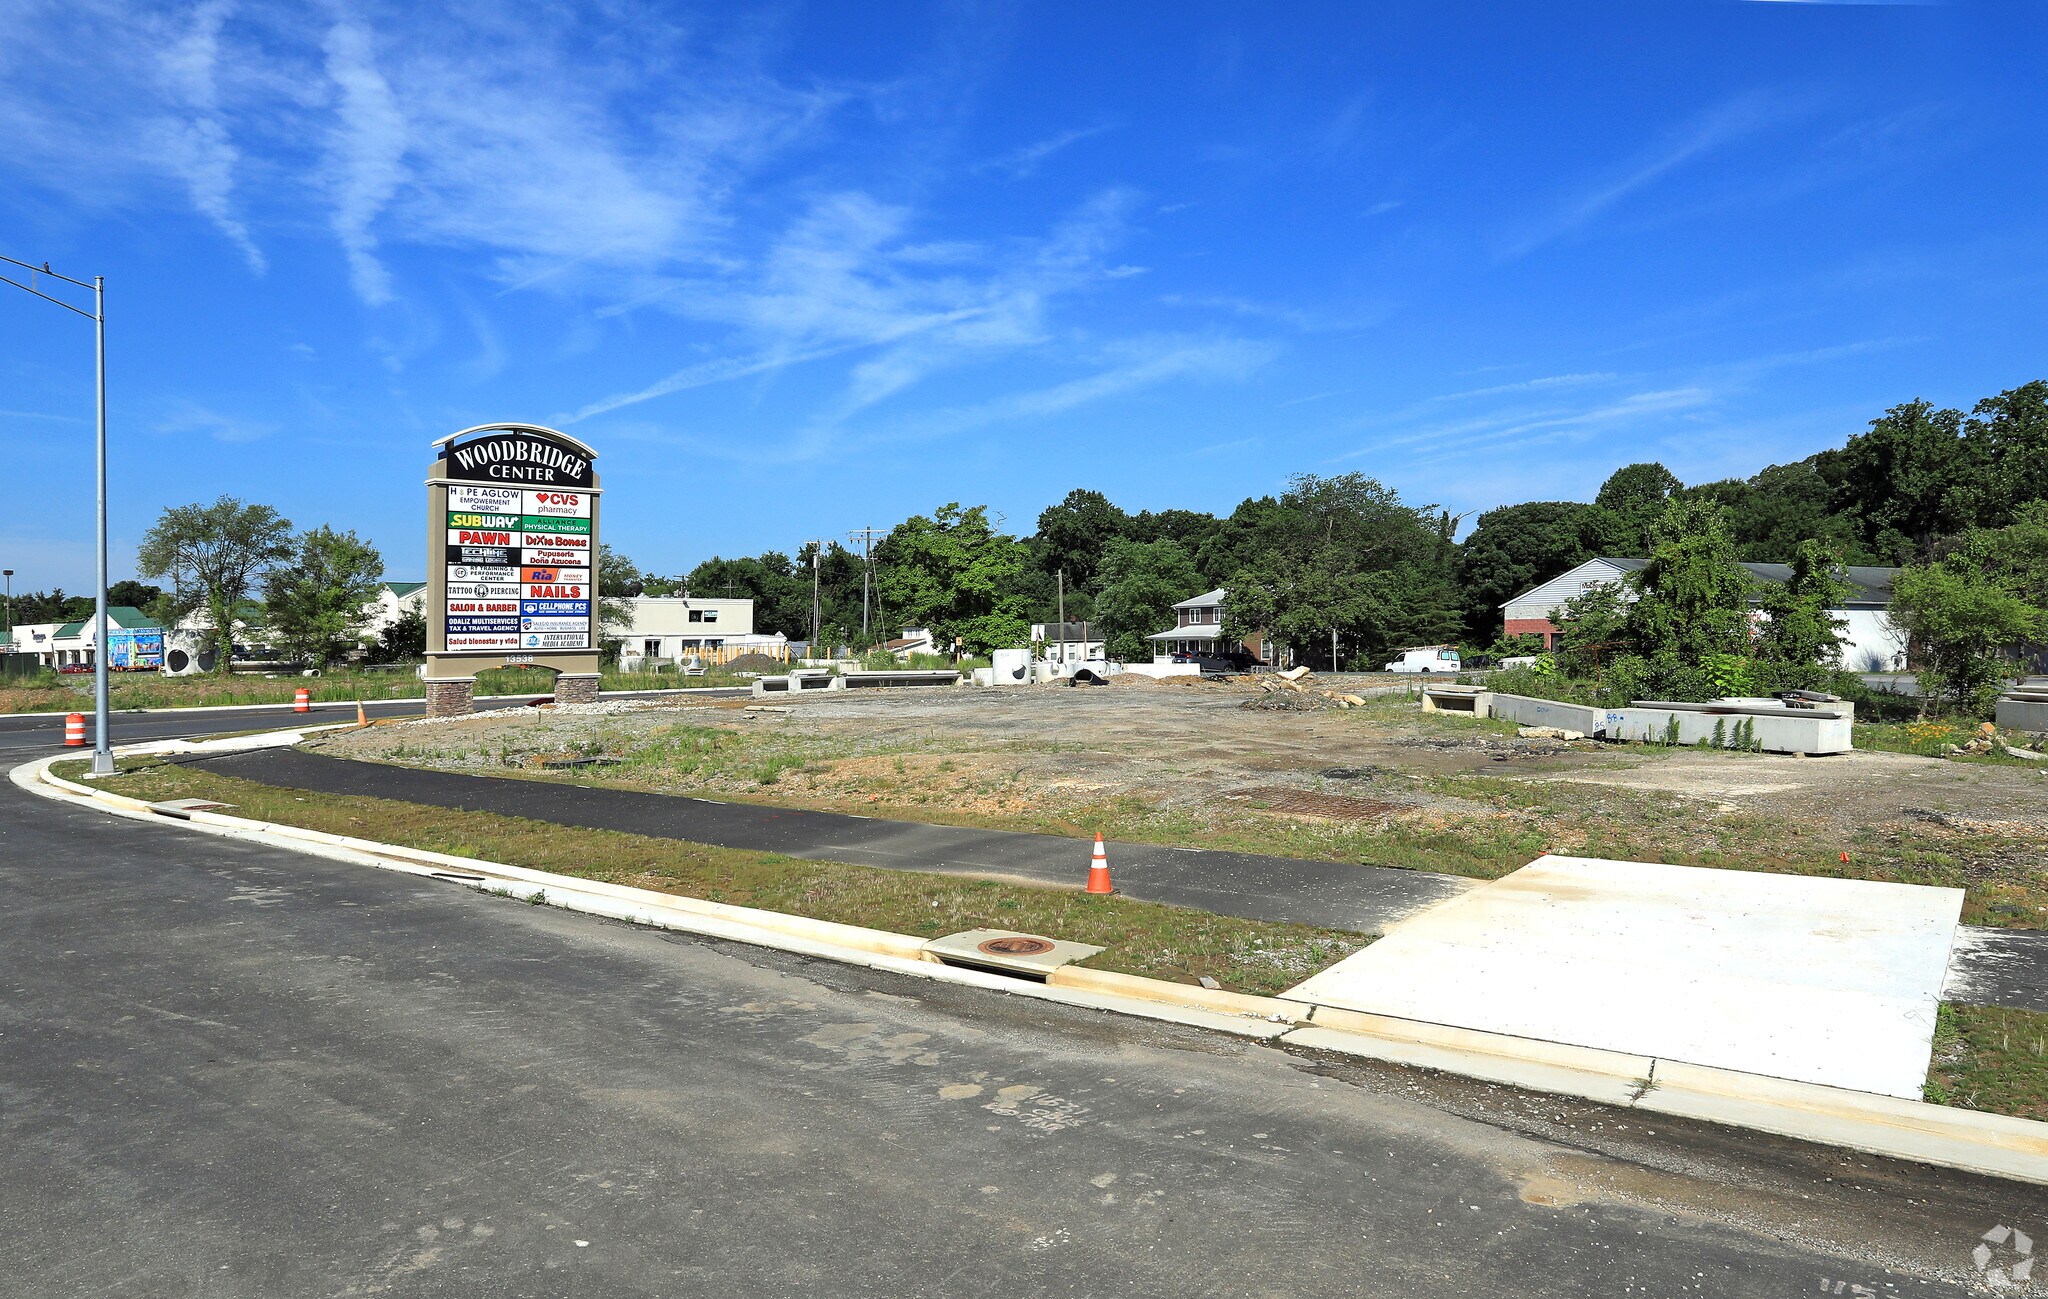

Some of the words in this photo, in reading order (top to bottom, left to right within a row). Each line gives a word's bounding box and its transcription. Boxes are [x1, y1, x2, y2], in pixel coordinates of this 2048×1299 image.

[454, 440, 587, 480] WOODBRIDGE
[489, 464, 555, 481] CENTER
[481, 489, 519, 498] AGLOW
[460, 497, 510, 505] EMPOWERMENT
[550, 493, 579, 506] CVS
[538, 505, 577, 515] pharmacy
[450, 514, 519, 528] SUBWAY
[459, 531, 510, 545] PAWN
[555, 536, 587, 547] Bones
[532, 569, 552, 580] Ria
[490, 587, 519, 595] PIERCING
[531, 585, 580, 598] NAILS
[450, 603, 475, 612] SALON
[477, 603, 483, 612] &
[486, 604, 517, 612] BARBER
[538, 602, 574, 610] CELLPHONE
[574, 602, 587, 610] PCS
[504, 655, 534, 663] 13538
